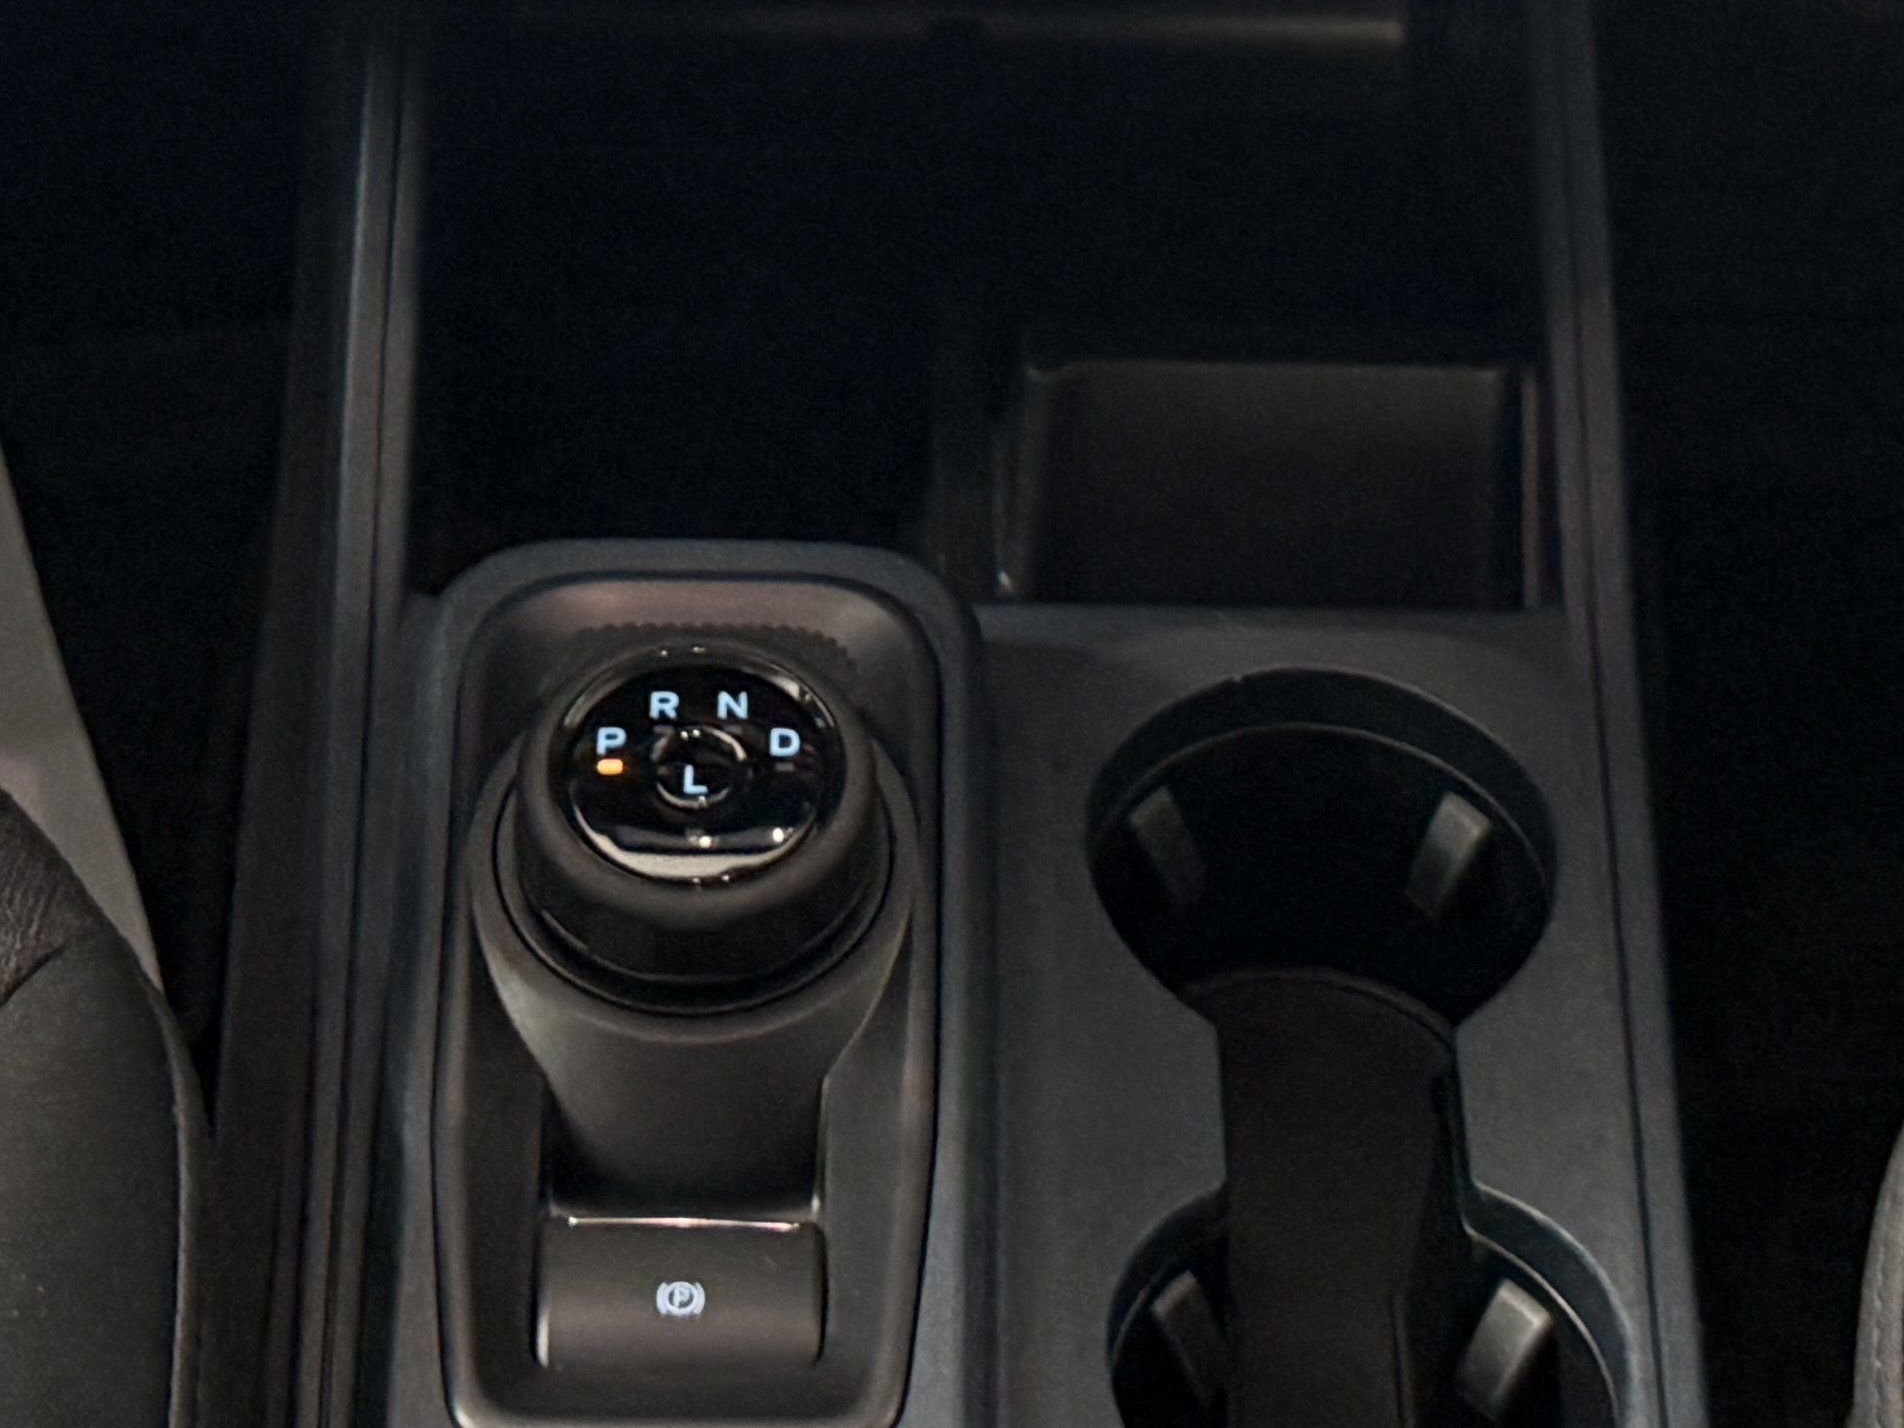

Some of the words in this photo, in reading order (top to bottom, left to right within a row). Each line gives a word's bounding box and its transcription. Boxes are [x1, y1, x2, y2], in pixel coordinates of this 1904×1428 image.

[649, 691, 679, 720] R
[717, 691, 748, 720] N
[596, 727, 626, 755] P
[769, 727, 800, 757] D
[683, 764, 708, 794] L
